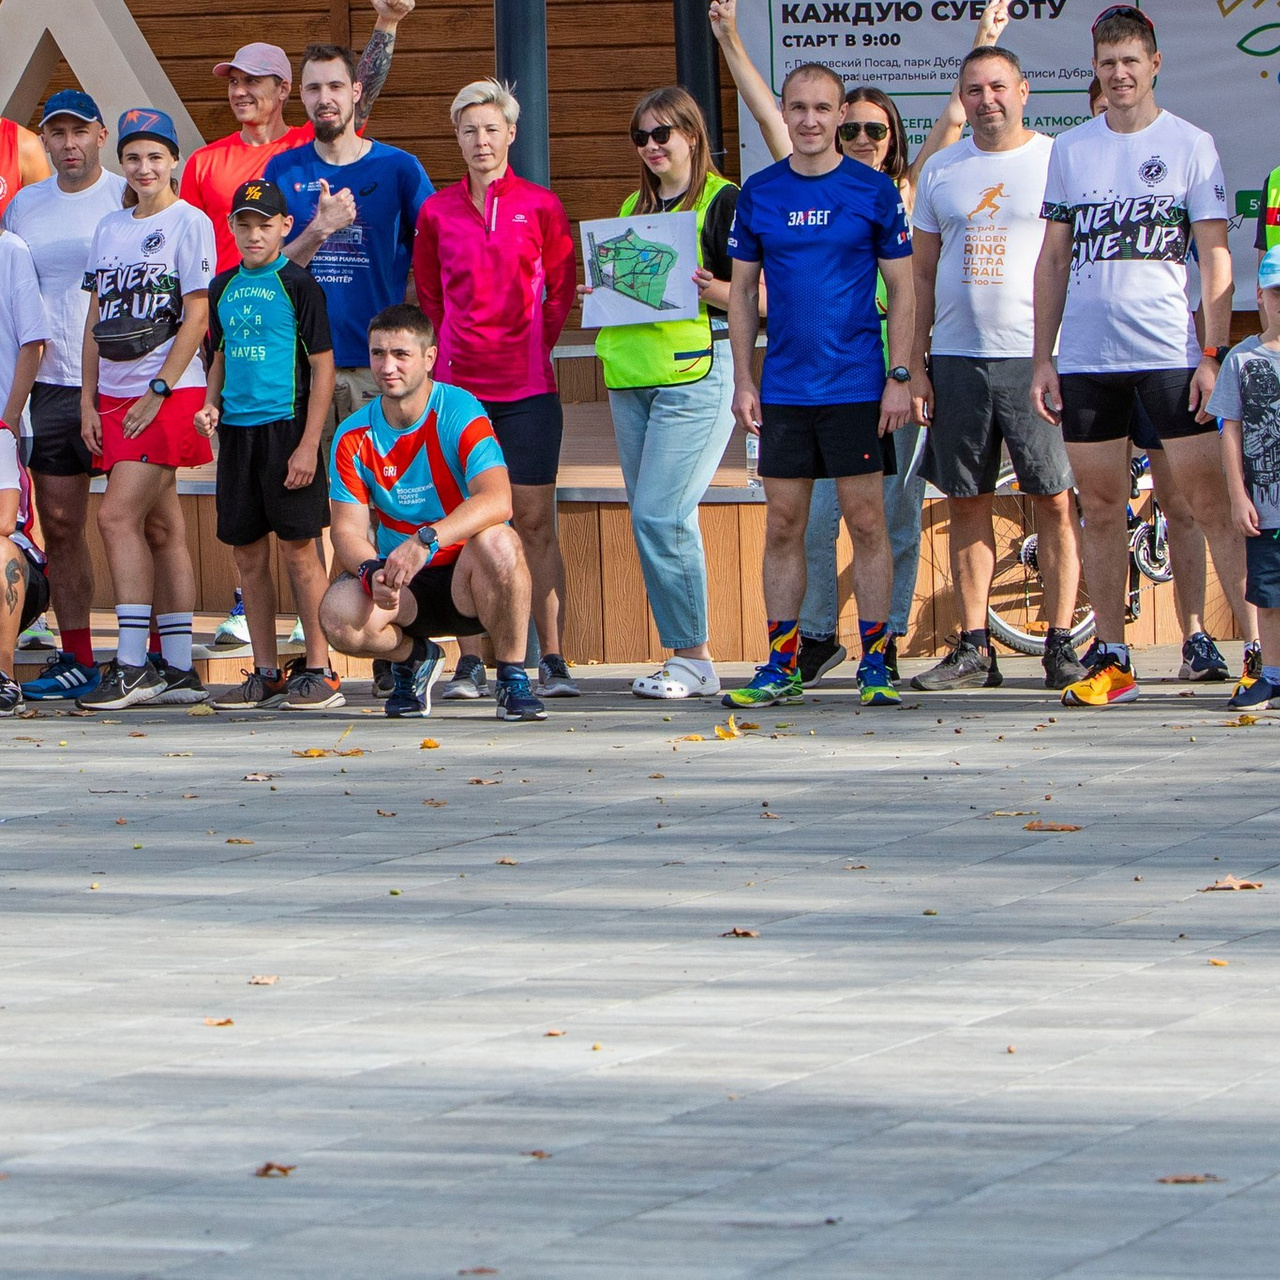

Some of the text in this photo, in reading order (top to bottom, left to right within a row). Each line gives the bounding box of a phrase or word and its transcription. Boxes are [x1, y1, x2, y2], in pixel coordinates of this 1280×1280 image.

[781, 0, 1067, 26] КАЖДУЮ СУБОТУ
[782, 33, 901, 48] СТАРТ В 9:00
[865, 57, 902, 70] Посад,
[904, 58, 931, 71] парк
[862, 70, 937, 82] центральный
[788, 209, 831, 226] ЗА БЕГ
[1074, 194, 1175, 238] NEVER
[964, 235, 1007, 243] GOLDEN
[1136, 225, 1179, 254] UP
[964, 243, 1006, 256] RING
[339, 256, 370, 264] МАРАФОН
[963, 257, 1004, 266] ULTRA
[962, 267, 1004, 277] TRAIL
[315, 274, 353, 284] ОЛОНТЁР
[227, 286, 276, 303] CATCHING
[131, 293, 171, 320] UP
[230, 346, 266, 358] WAVES
